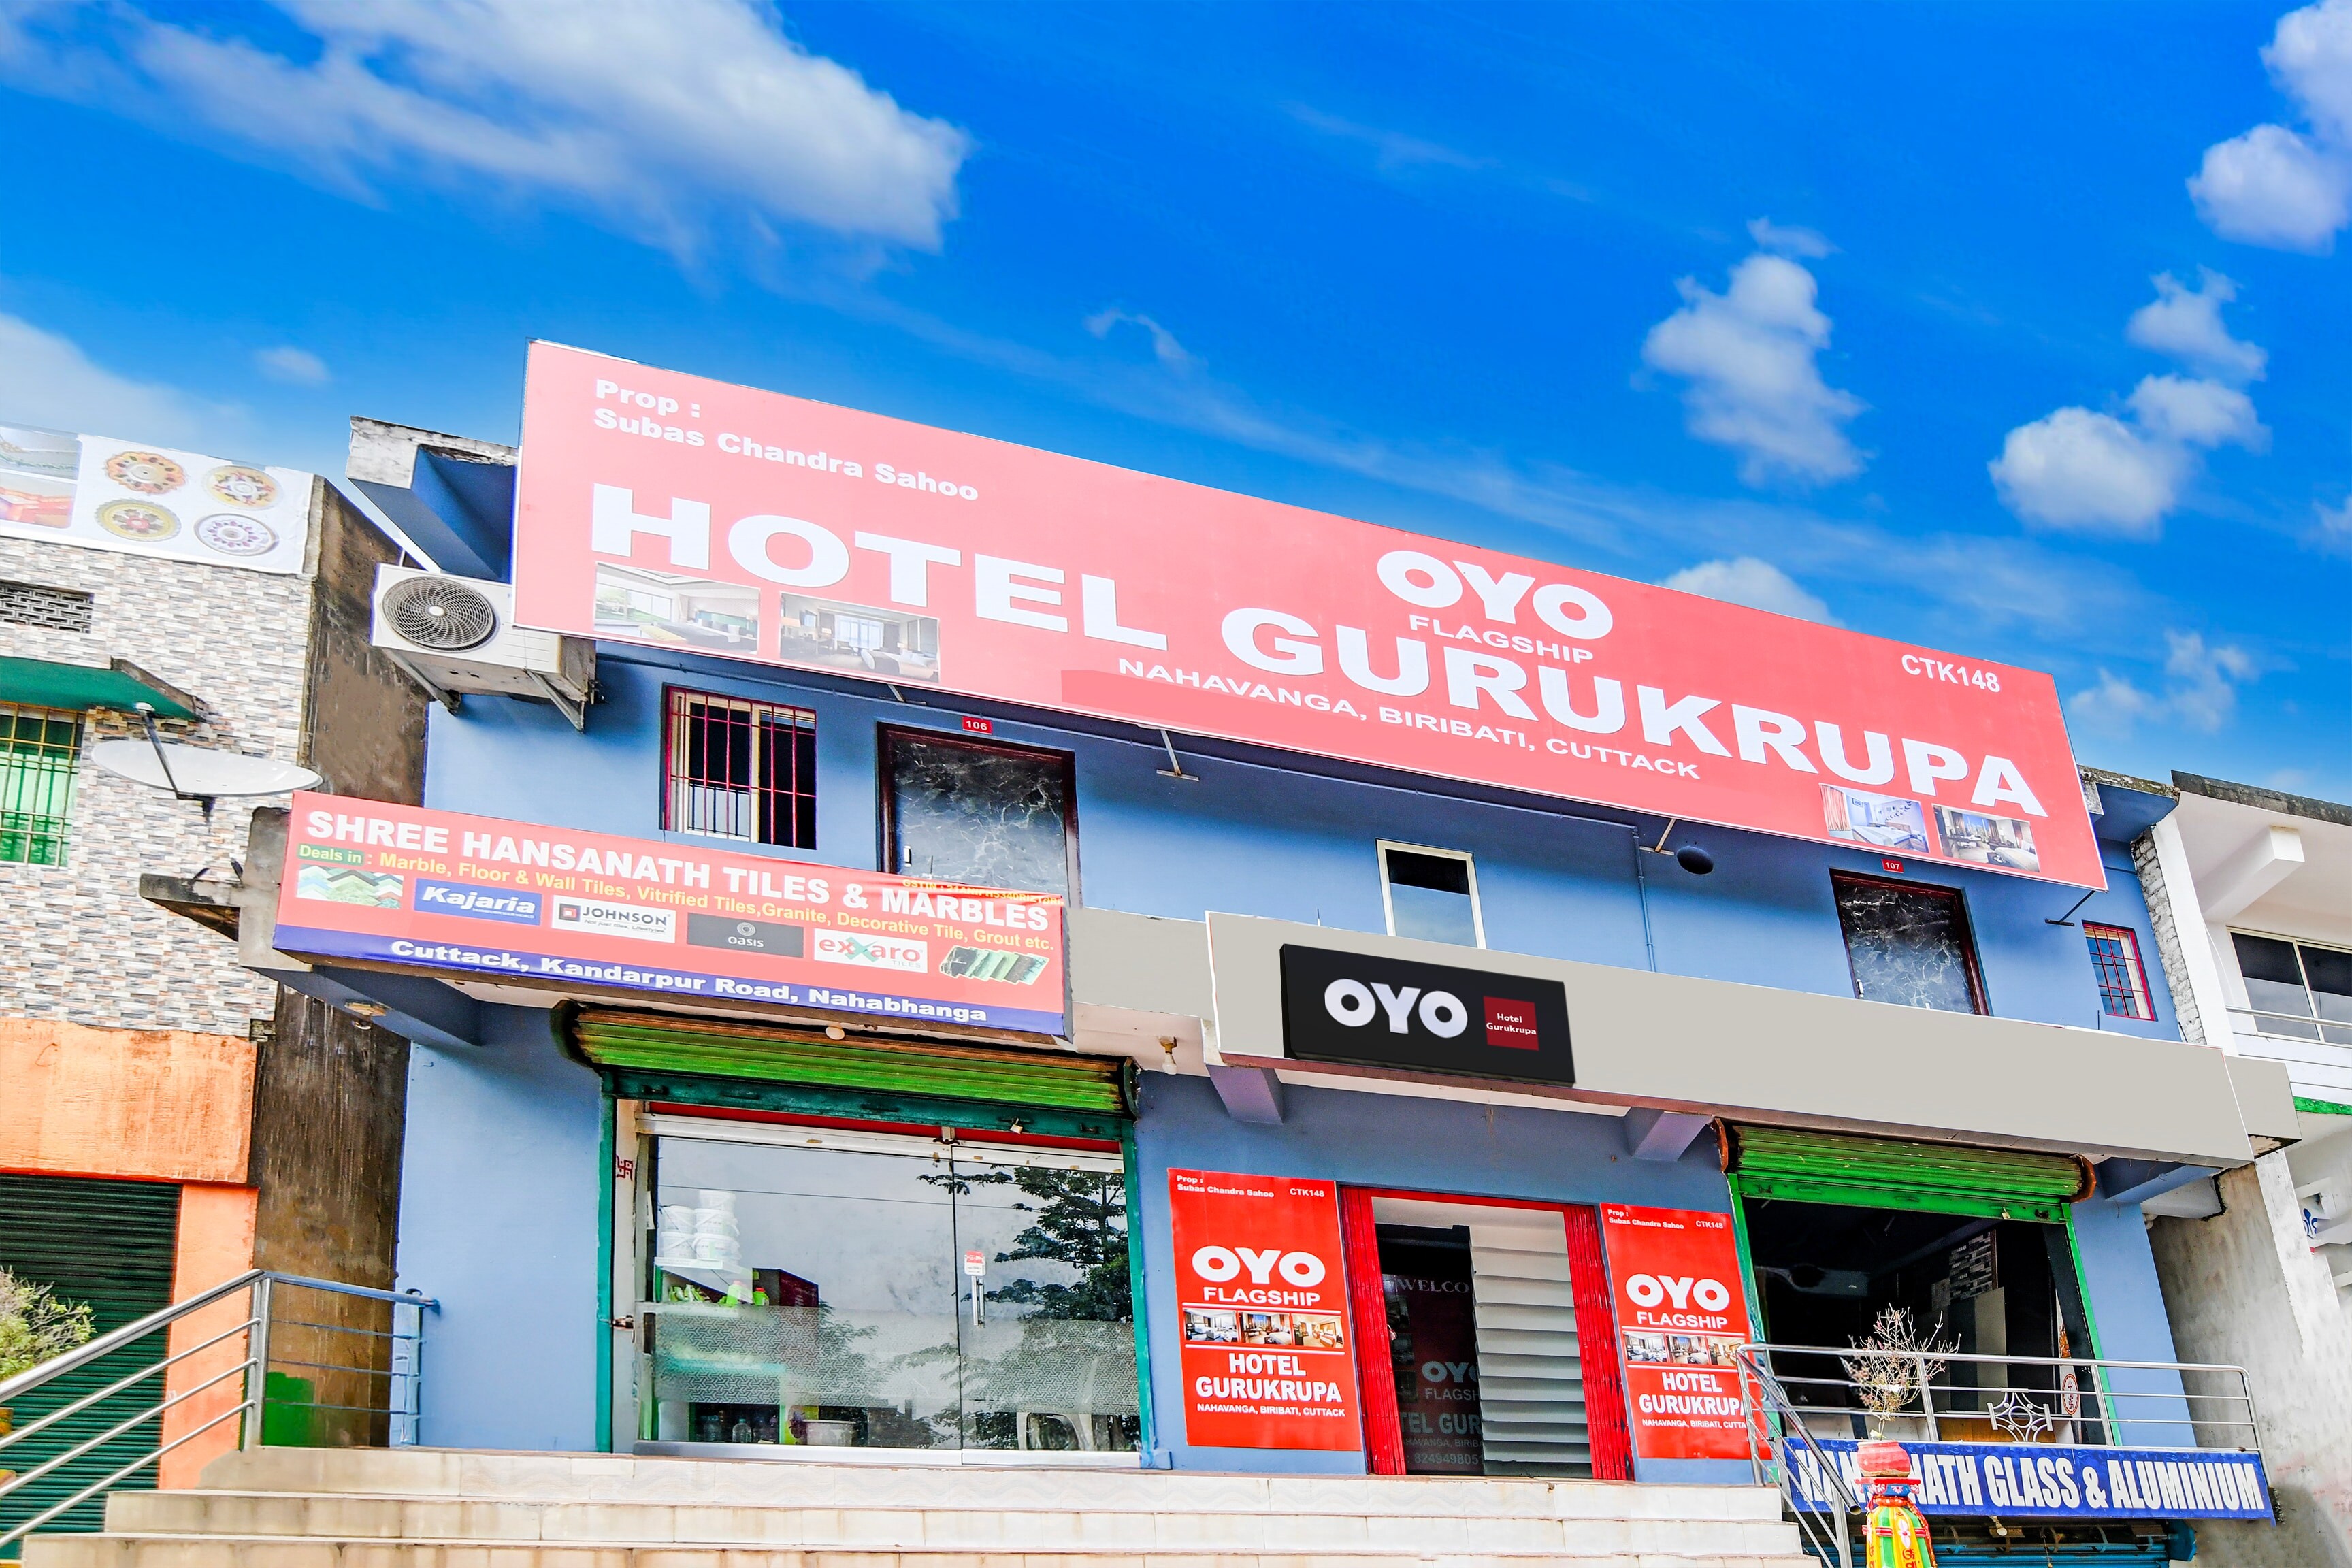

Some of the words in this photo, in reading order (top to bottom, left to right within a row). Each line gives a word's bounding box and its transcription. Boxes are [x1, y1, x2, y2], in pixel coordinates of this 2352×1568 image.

[596, 379, 679, 416] Prop
[693, 402, 701, 419] :
[594, 408, 704, 447] Subas
[717, 432, 863, 479] Chandra
[875, 463, 979, 502] Sahoo
[1376, 550, 1614, 640] OYO
[1409, 614, 1594, 664] FLAGSHIP
[591, 483, 1168, 651] HOTEL
[1222, 607, 2048, 817] GURUKRUPA
[1901, 653, 2001, 693] CTK148
[966, 720, 988, 730] 106
[1118, 658, 1367, 721] NAHAVANGA,
[1379, 706, 1535, 753] BIRIBATI,
[1546, 738, 1700, 780] CUTTACK
[306, 811, 449, 854] SHREE
[463, 831, 710, 888] HANSANATH
[723, 866, 830, 904] TILES
[843, 883, 868, 909] &
[882, 888, 1049, 931] MARBLES
[1885, 862, 1900, 870] 107
[902, 879, 936, 890] GSTIN
[299, 845, 343, 861] Deals
[348, 851, 362, 863] in
[380, 852, 452, 877] Marble,
[459, 862, 510, 881] Floor
[515, 870, 529, 885] &
[536, 872, 575, 890] Wall
[582, 878, 631, 900] Tiles,
[636, 885, 708, 908] Vitrified
[837, 911, 928, 935] Decorative
[934, 924, 968, 943] Tile,
[974, 929, 1020, 947] Grout
[1025, 936, 1054, 950] etc.
[422, 886, 536, 914] Kajaria
[583, 906, 666, 926] JOHNSON
[892, 960, 921, 968] TILES
[391, 940, 529, 973] Cuttack,
[541, 957, 706, 990] Kandarpur
[715, 977, 800, 1003] Road,
[808, 989, 987, 1022] Nahabhanga
[1324, 978, 1468, 1039] OYO
[1497, 1013, 1522, 1024] Hotel
[1486, 1022, 1537, 1036] Gurukrupa
[1177, 1175, 1198, 1184] Prop
[1177, 1183, 1205, 1194] Subas
[1207, 1186, 1245, 1196] Chandra
[1247, 1188, 1275, 1198] Sahoo
[1290, 1188, 1325, 1198] CTK148
[1608, 1217, 1630, 1226] Subas
[1632, 1219, 1661, 1228] Chandra
[1663, 1221, 1684, 1230] Sahoo
[1695, 1220, 1723, 1230] CTK148
[1192, 1245, 1326, 1288] OYO
[1203, 1286, 1321, 1307] FLAGSHIP
[1397, 1279, 1472, 1293] WELCO
[1626, 1273, 1730, 1311] OYO
[1637, 1311, 1728, 1329] FLAGSHIP
[1229, 1353, 1307, 1377] HOTEL
[1196, 1377, 1343, 1403] GURUKRUPA
[1661, 1372, 1722, 1392] HOTEL
[1425, 1388, 1480, 1401] FLAGSH
[1197, 1403, 1258, 1415] NAHAVANGA,
[1260, 1405, 1301, 1416] BIRIBATI,
[1303, 1407, 1345, 1417] CUTTACK
[1400, 1411, 1433, 1434] TEL
[1439, 1413, 1482, 1435] GUR
[1642, 1419, 1689, 1428] NAHAVANGA,
[1690, 1420, 1722, 1429] BIRIBATI,
[1723, 1421, 1748, 1429] CUTTA
[1795, 1449, 1983, 1505] HANNATH
[1985, 1454, 2080, 1509] GLASS
[2085, 1465, 2107, 1509] &
[2107, 1460, 2265, 1511] ALUMINIUM
